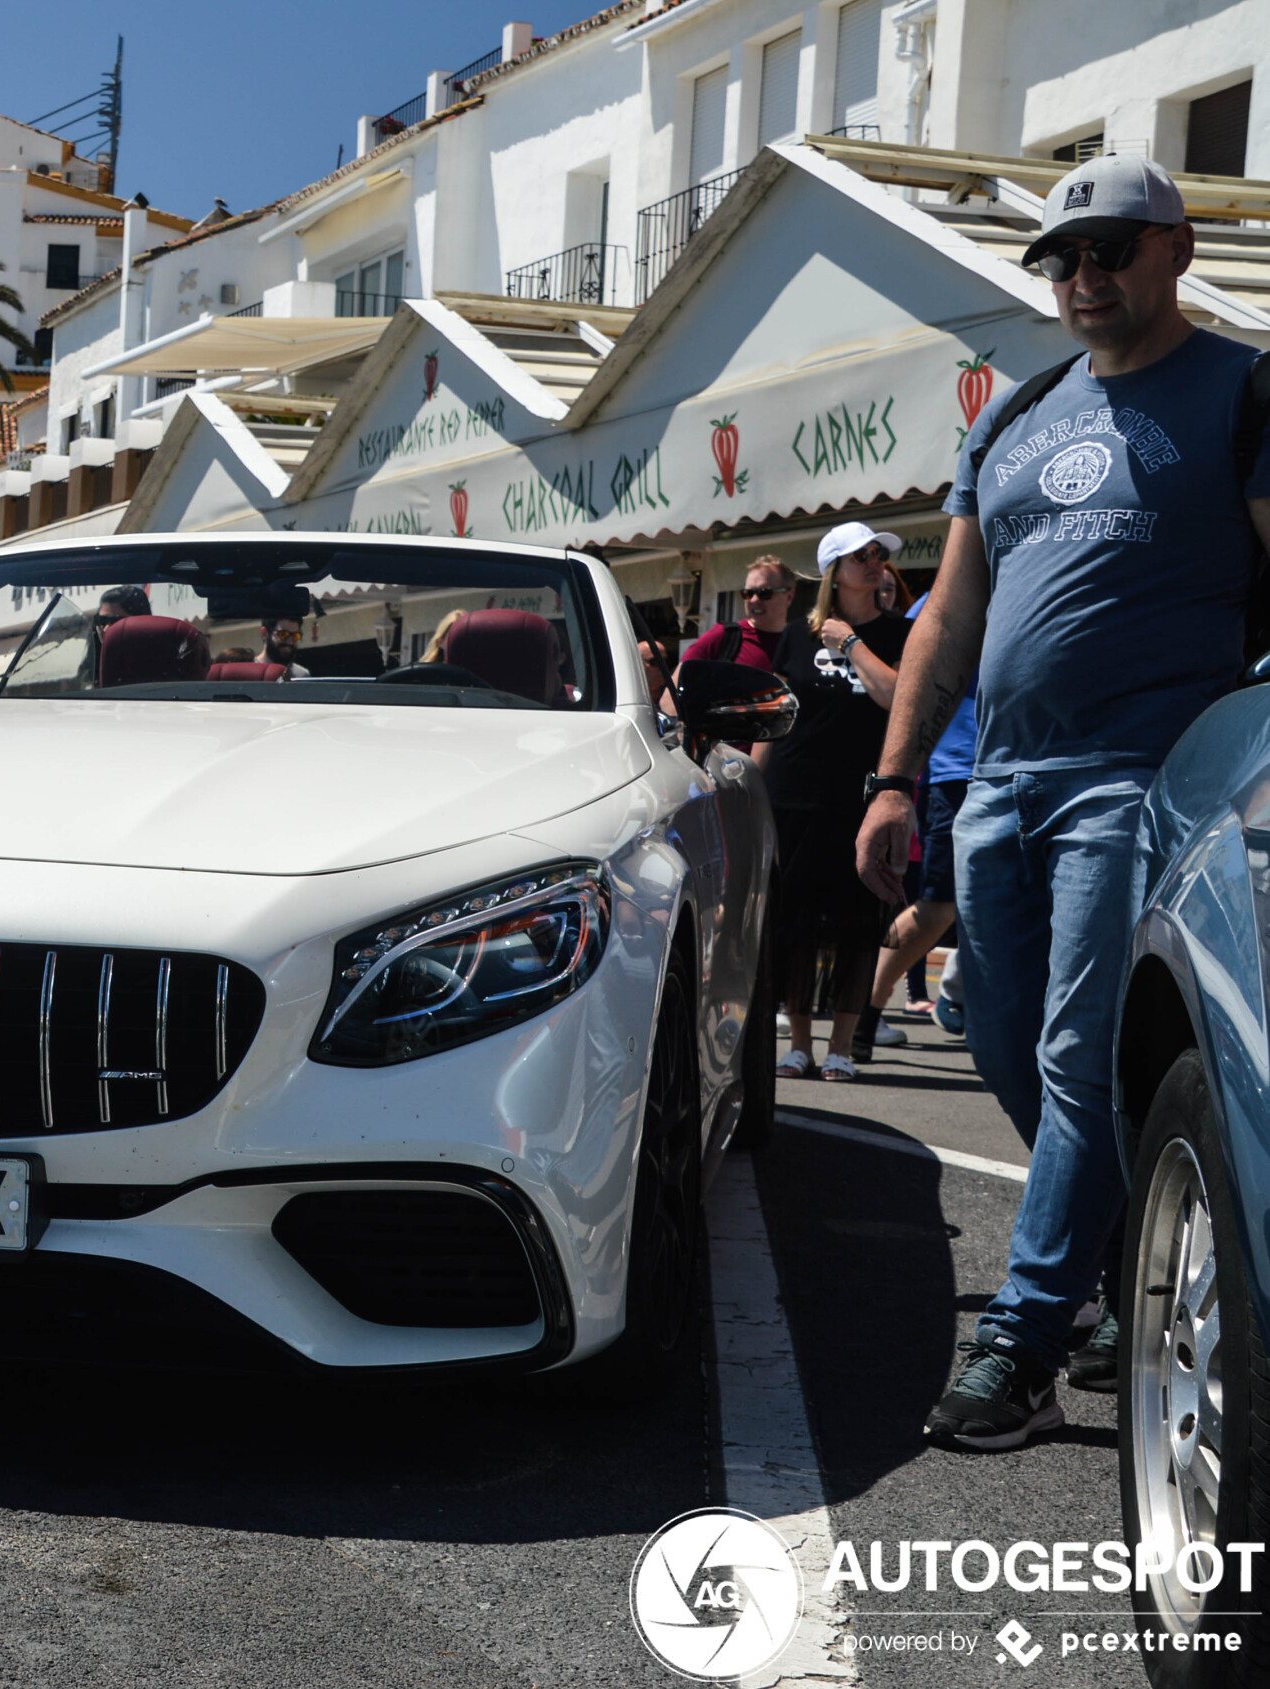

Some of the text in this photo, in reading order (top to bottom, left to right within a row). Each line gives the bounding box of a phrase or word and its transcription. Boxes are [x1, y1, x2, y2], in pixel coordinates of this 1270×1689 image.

[357, 397, 506, 469] RESTAURANTE RED PEPPER
[792, 395, 896, 479] CARNES
[995, 407, 1181, 487] ABERCROMBIE
[502, 445, 671, 535] CHARCOAL GRILL
[993, 509, 1158, 548] AND FITCH
[119, 1071, 163, 1079] AMG
